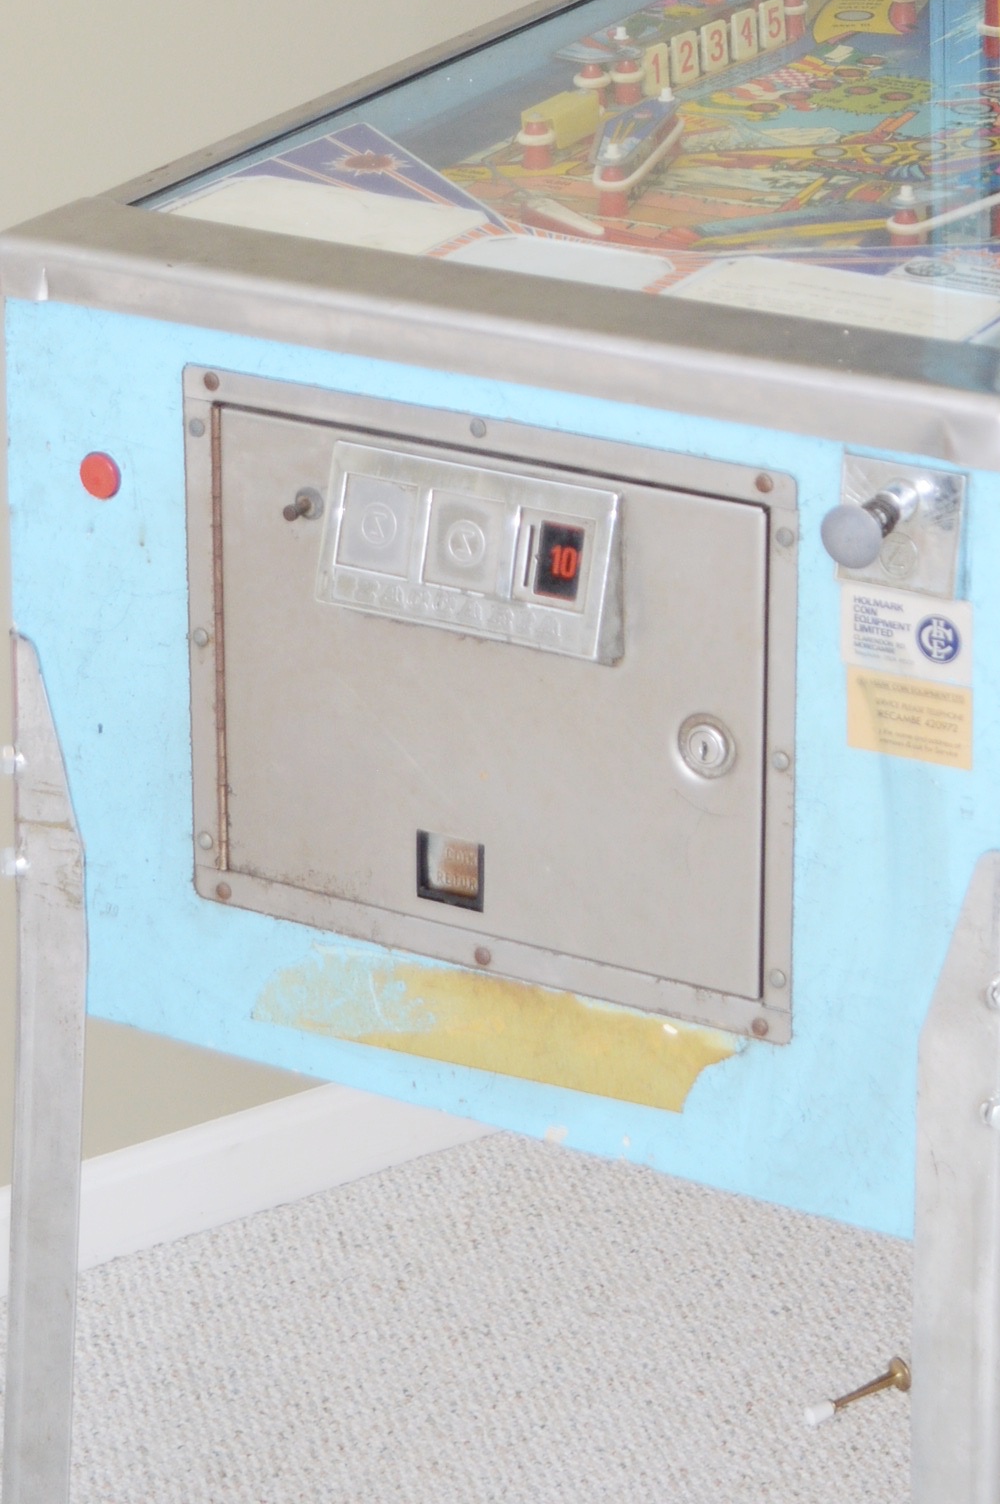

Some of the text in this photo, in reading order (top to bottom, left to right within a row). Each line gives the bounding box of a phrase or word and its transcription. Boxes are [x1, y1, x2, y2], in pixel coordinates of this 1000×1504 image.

[651, 6, 782, 85] 1 2 3 4 5
[551, 544, 579, 581] 10
[853, 594, 904, 612] HOLMARK
[853, 604, 878, 617] COIN
[854, 613, 912, 632] EQUIPMENT
[854, 623, 894, 637] LIMITED
